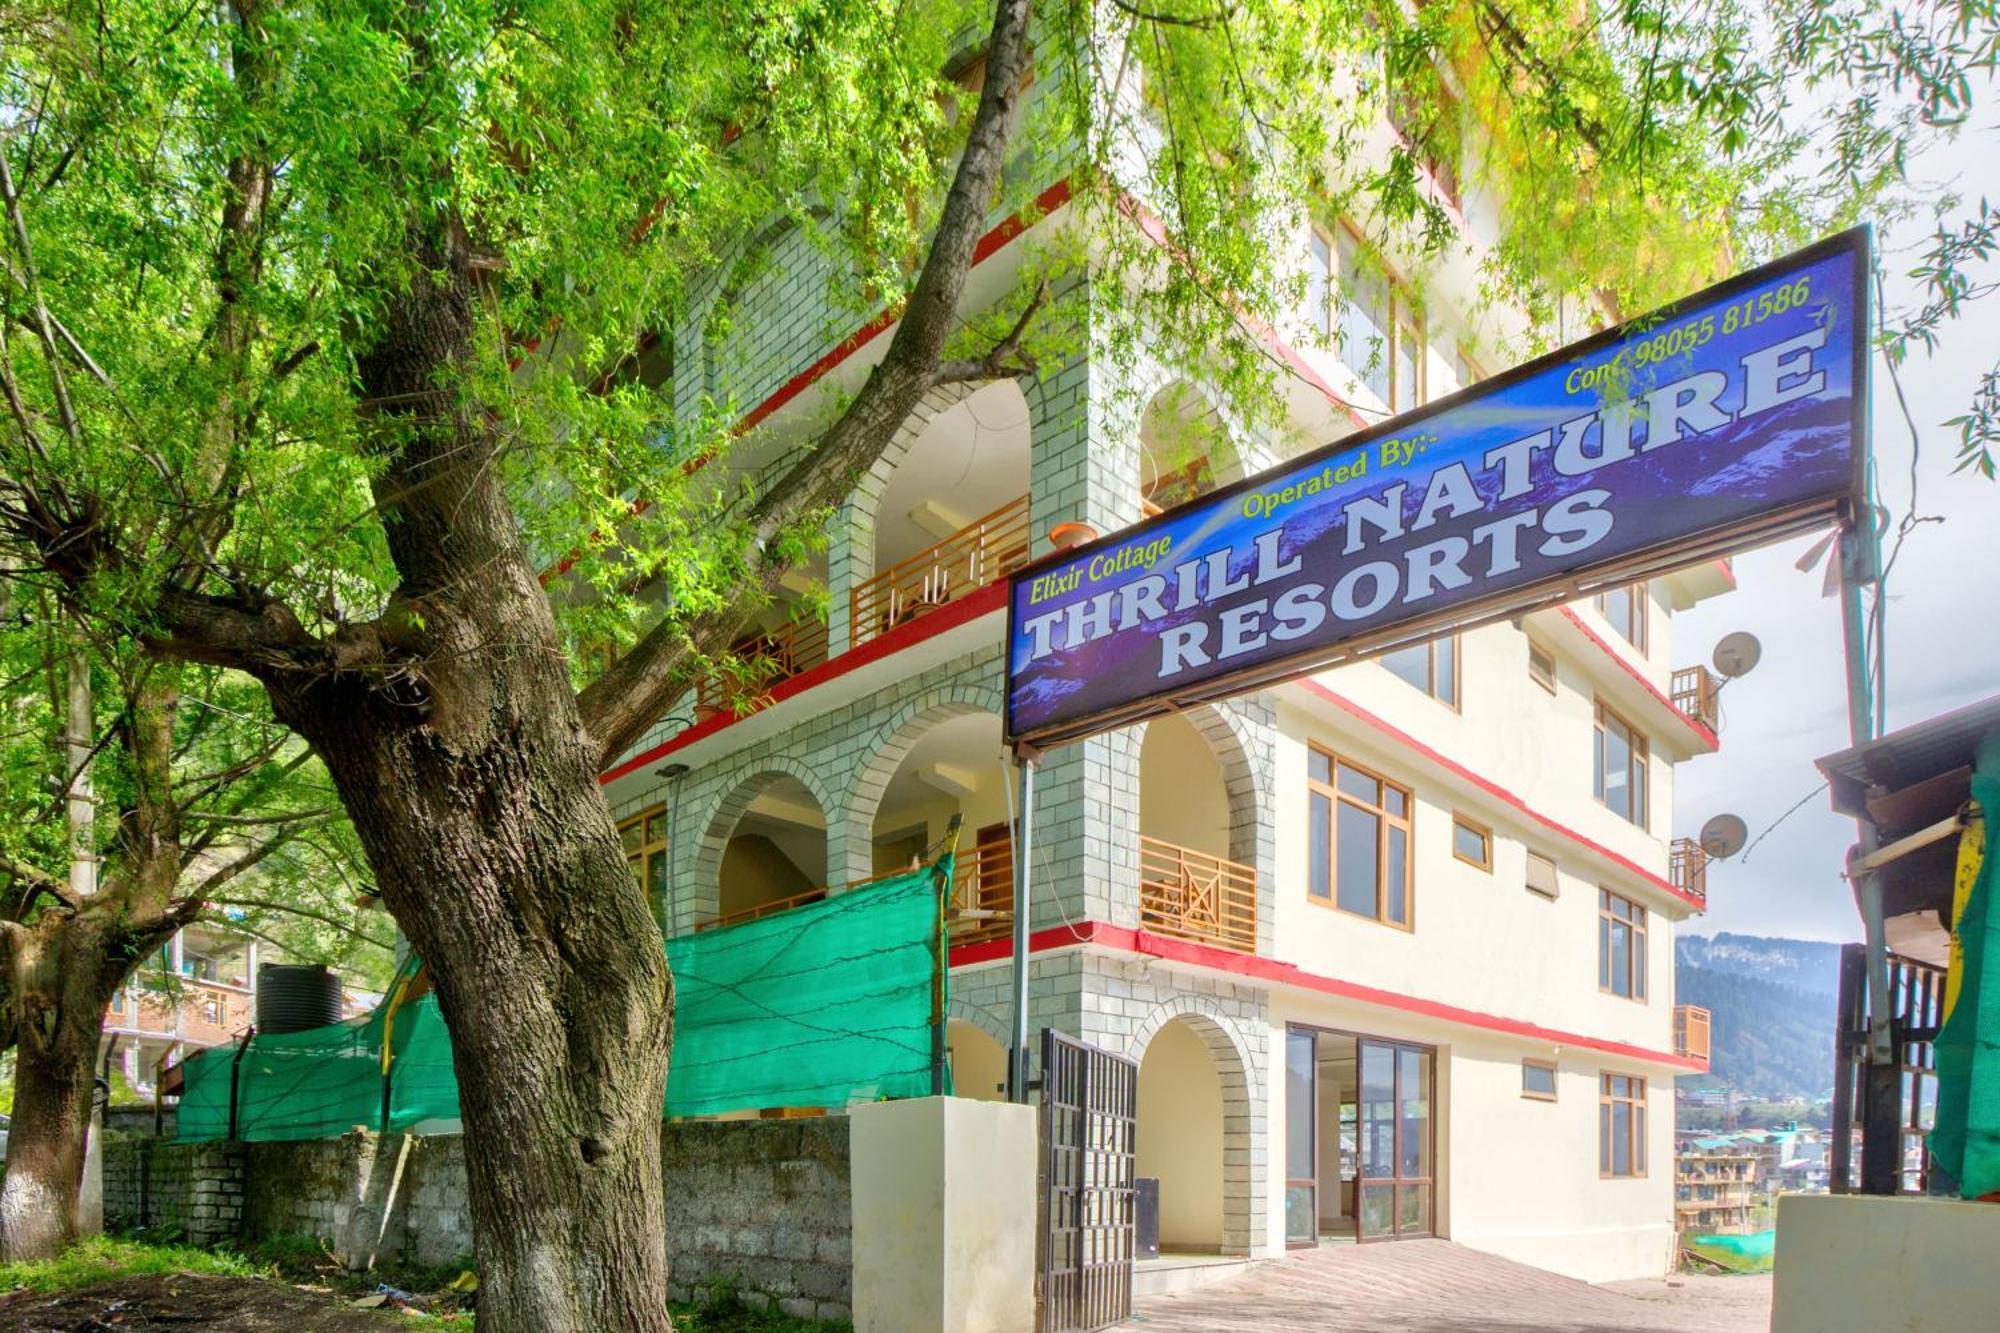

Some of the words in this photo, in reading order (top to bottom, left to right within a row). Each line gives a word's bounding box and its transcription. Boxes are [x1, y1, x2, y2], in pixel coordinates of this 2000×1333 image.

[1635, 315, 1715, 369] 98055
[1721, 276, 1811, 335] 81586
[1024, 527, 1303, 663] THRILL
[1342, 327, 1827, 556] NATURE
[1242, 452, 1367, 519] Operated
[1030, 565, 1083, 605] Elixir
[1088, 535, 1171, 582] Cottage
[1157, 489, 1614, 678] RESORTS
